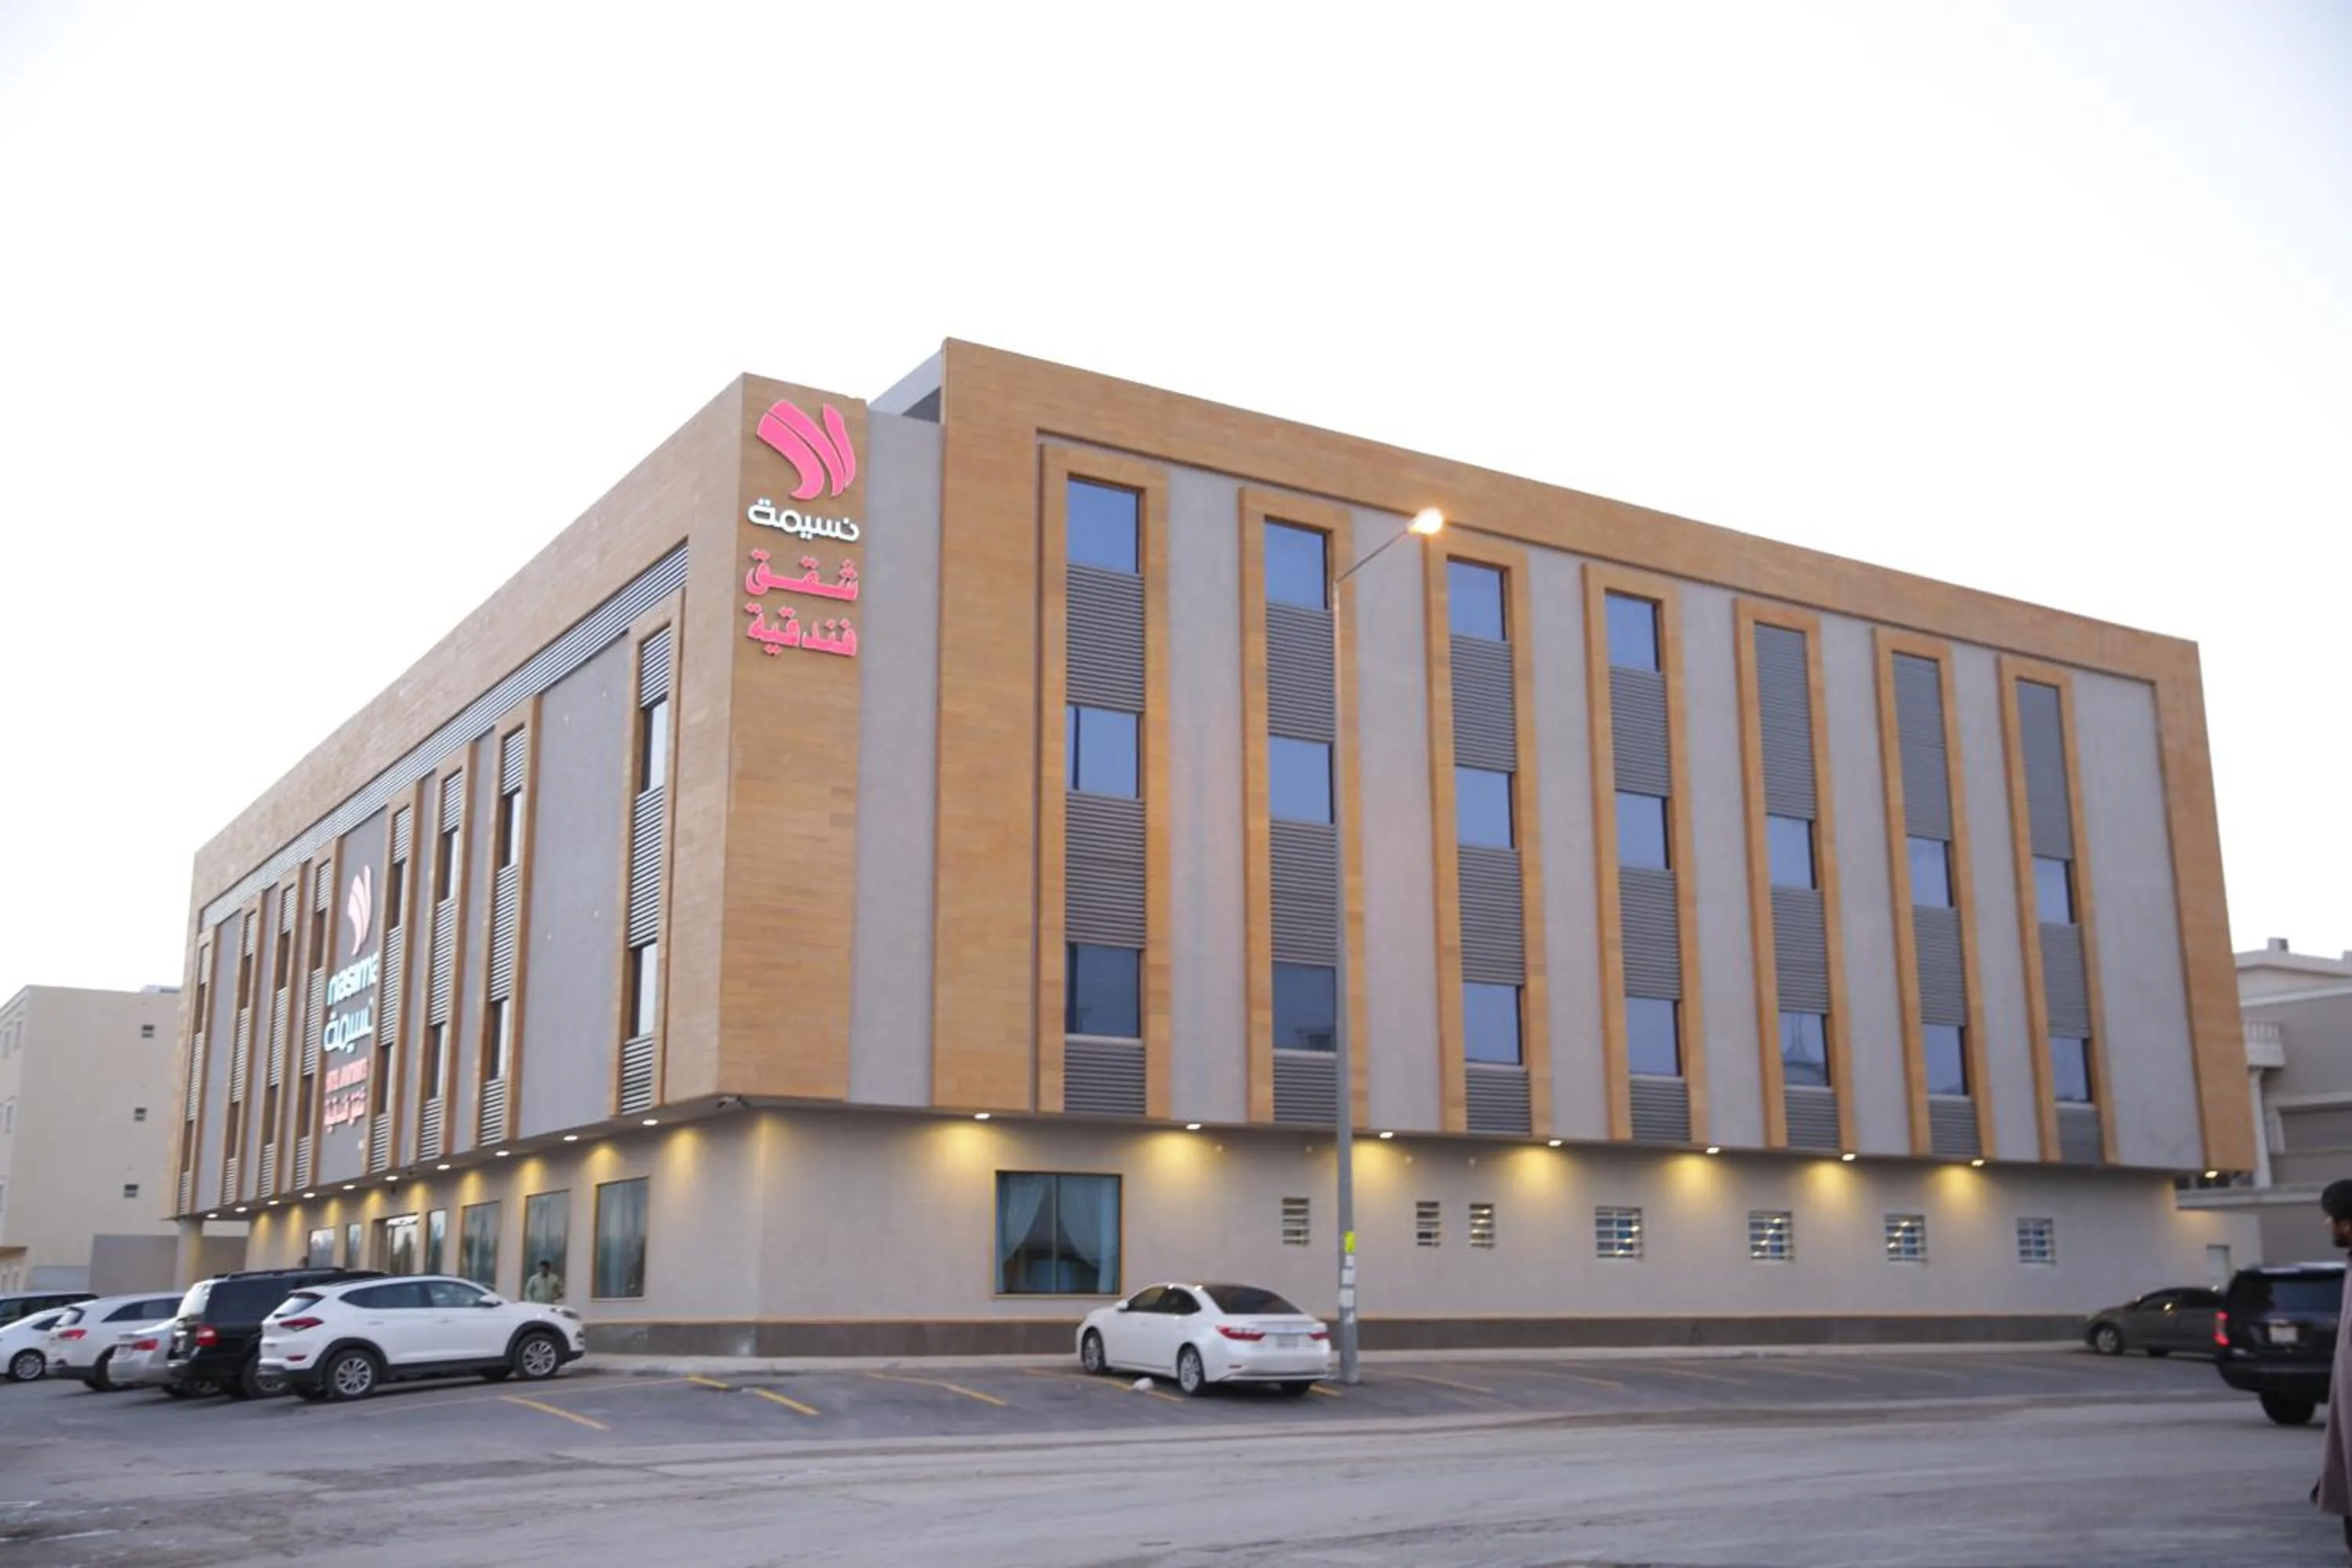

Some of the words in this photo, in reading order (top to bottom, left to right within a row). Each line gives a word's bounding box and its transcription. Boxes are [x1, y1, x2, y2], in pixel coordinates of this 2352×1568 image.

[747, 498, 860, 542] نسيمة
[746, 549, 858, 601] شقق
[744, 602, 857, 656] فندقية
